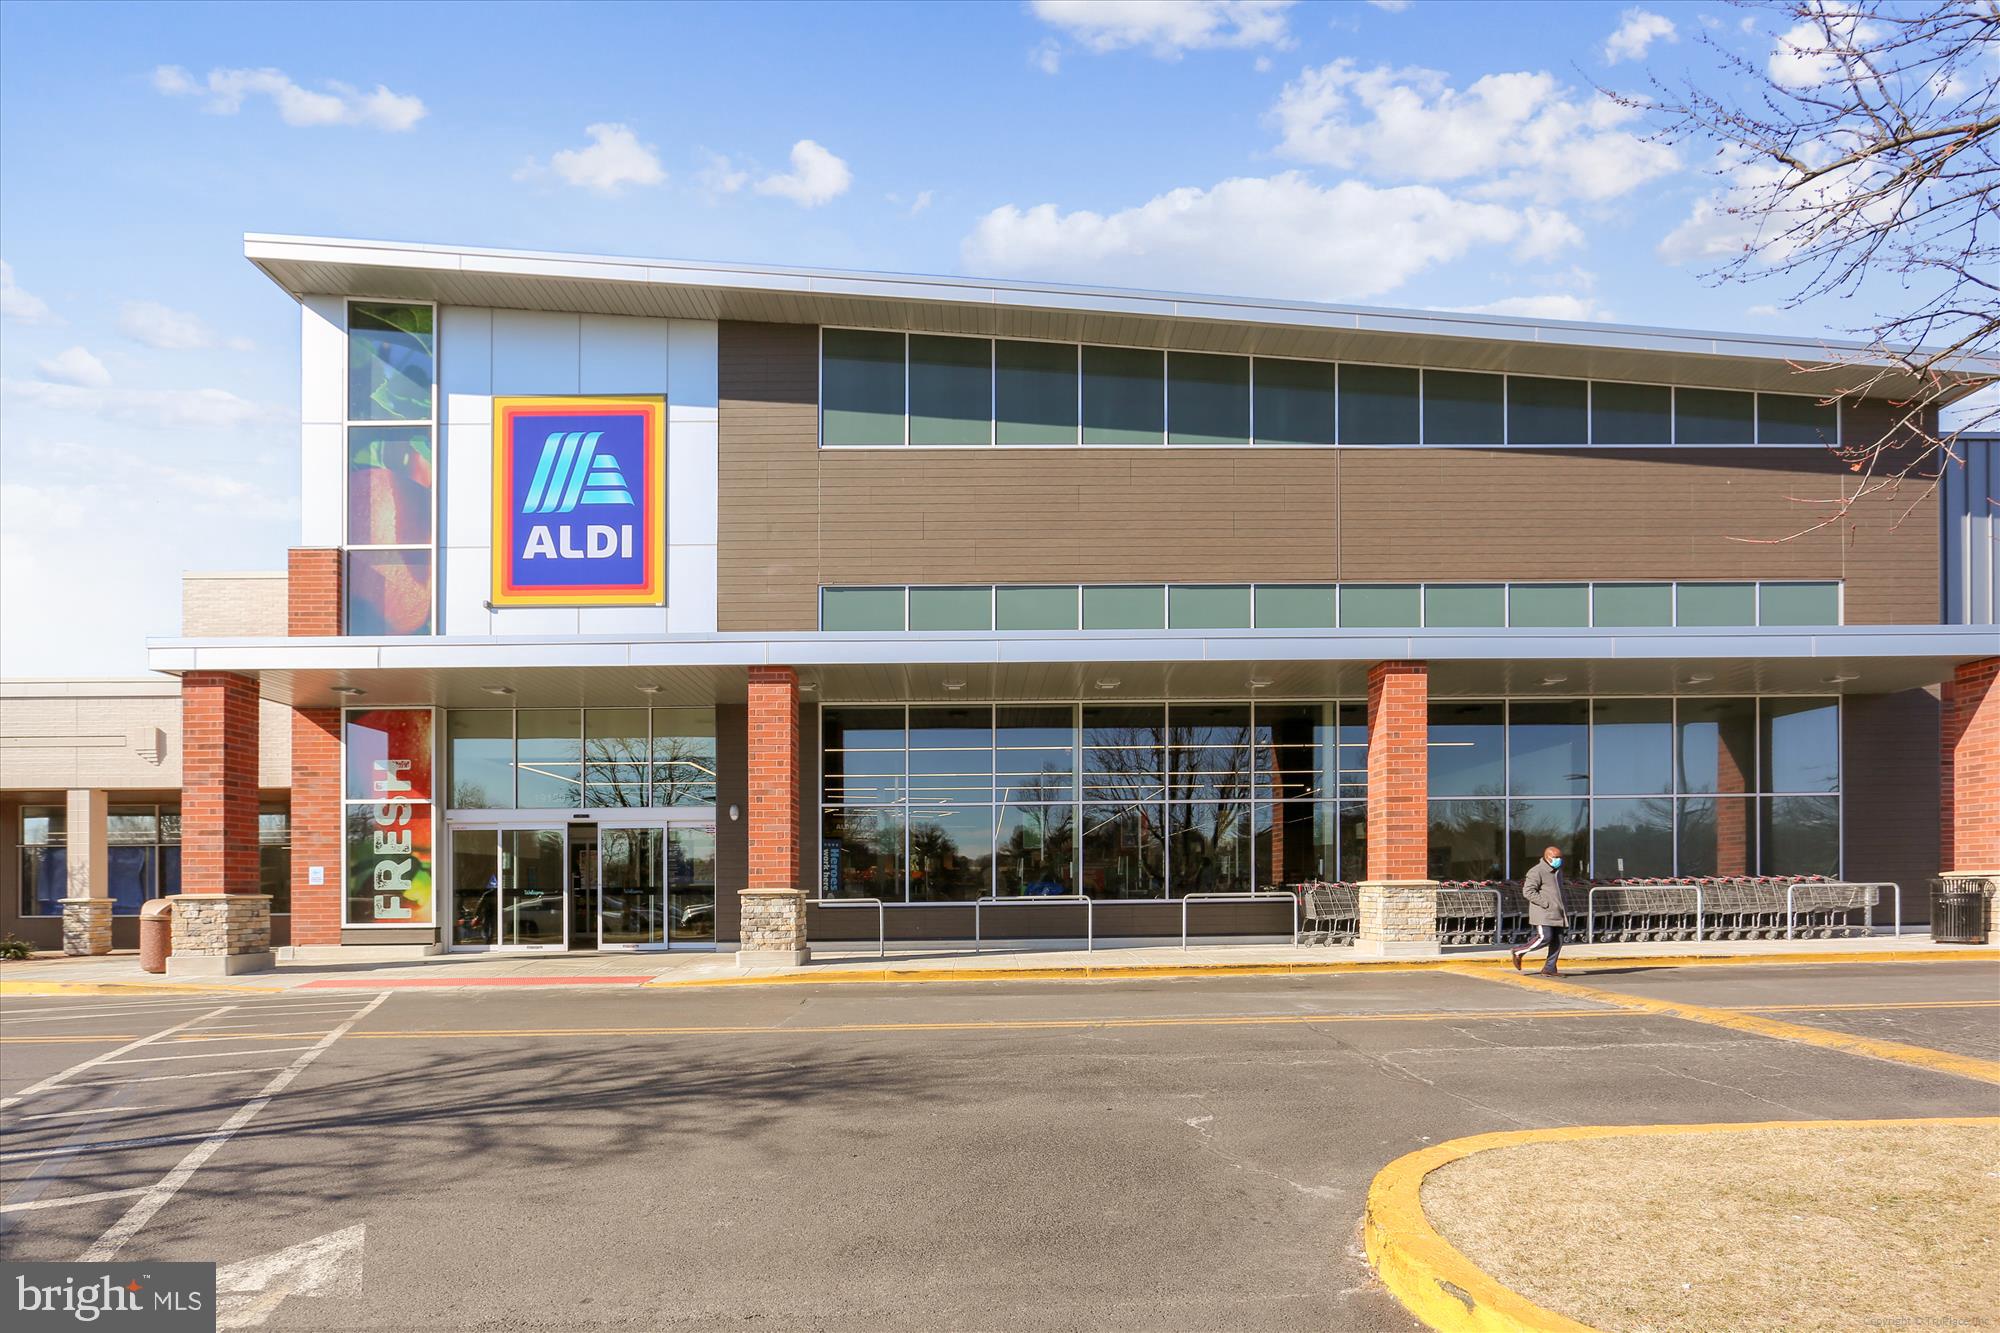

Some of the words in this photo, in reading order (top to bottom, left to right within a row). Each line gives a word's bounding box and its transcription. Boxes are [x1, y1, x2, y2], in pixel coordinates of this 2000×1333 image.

[522, 525, 632, 559] ALDI
[374, 759, 412, 919] FRESH
[830, 848, 840, 890] Heroes
